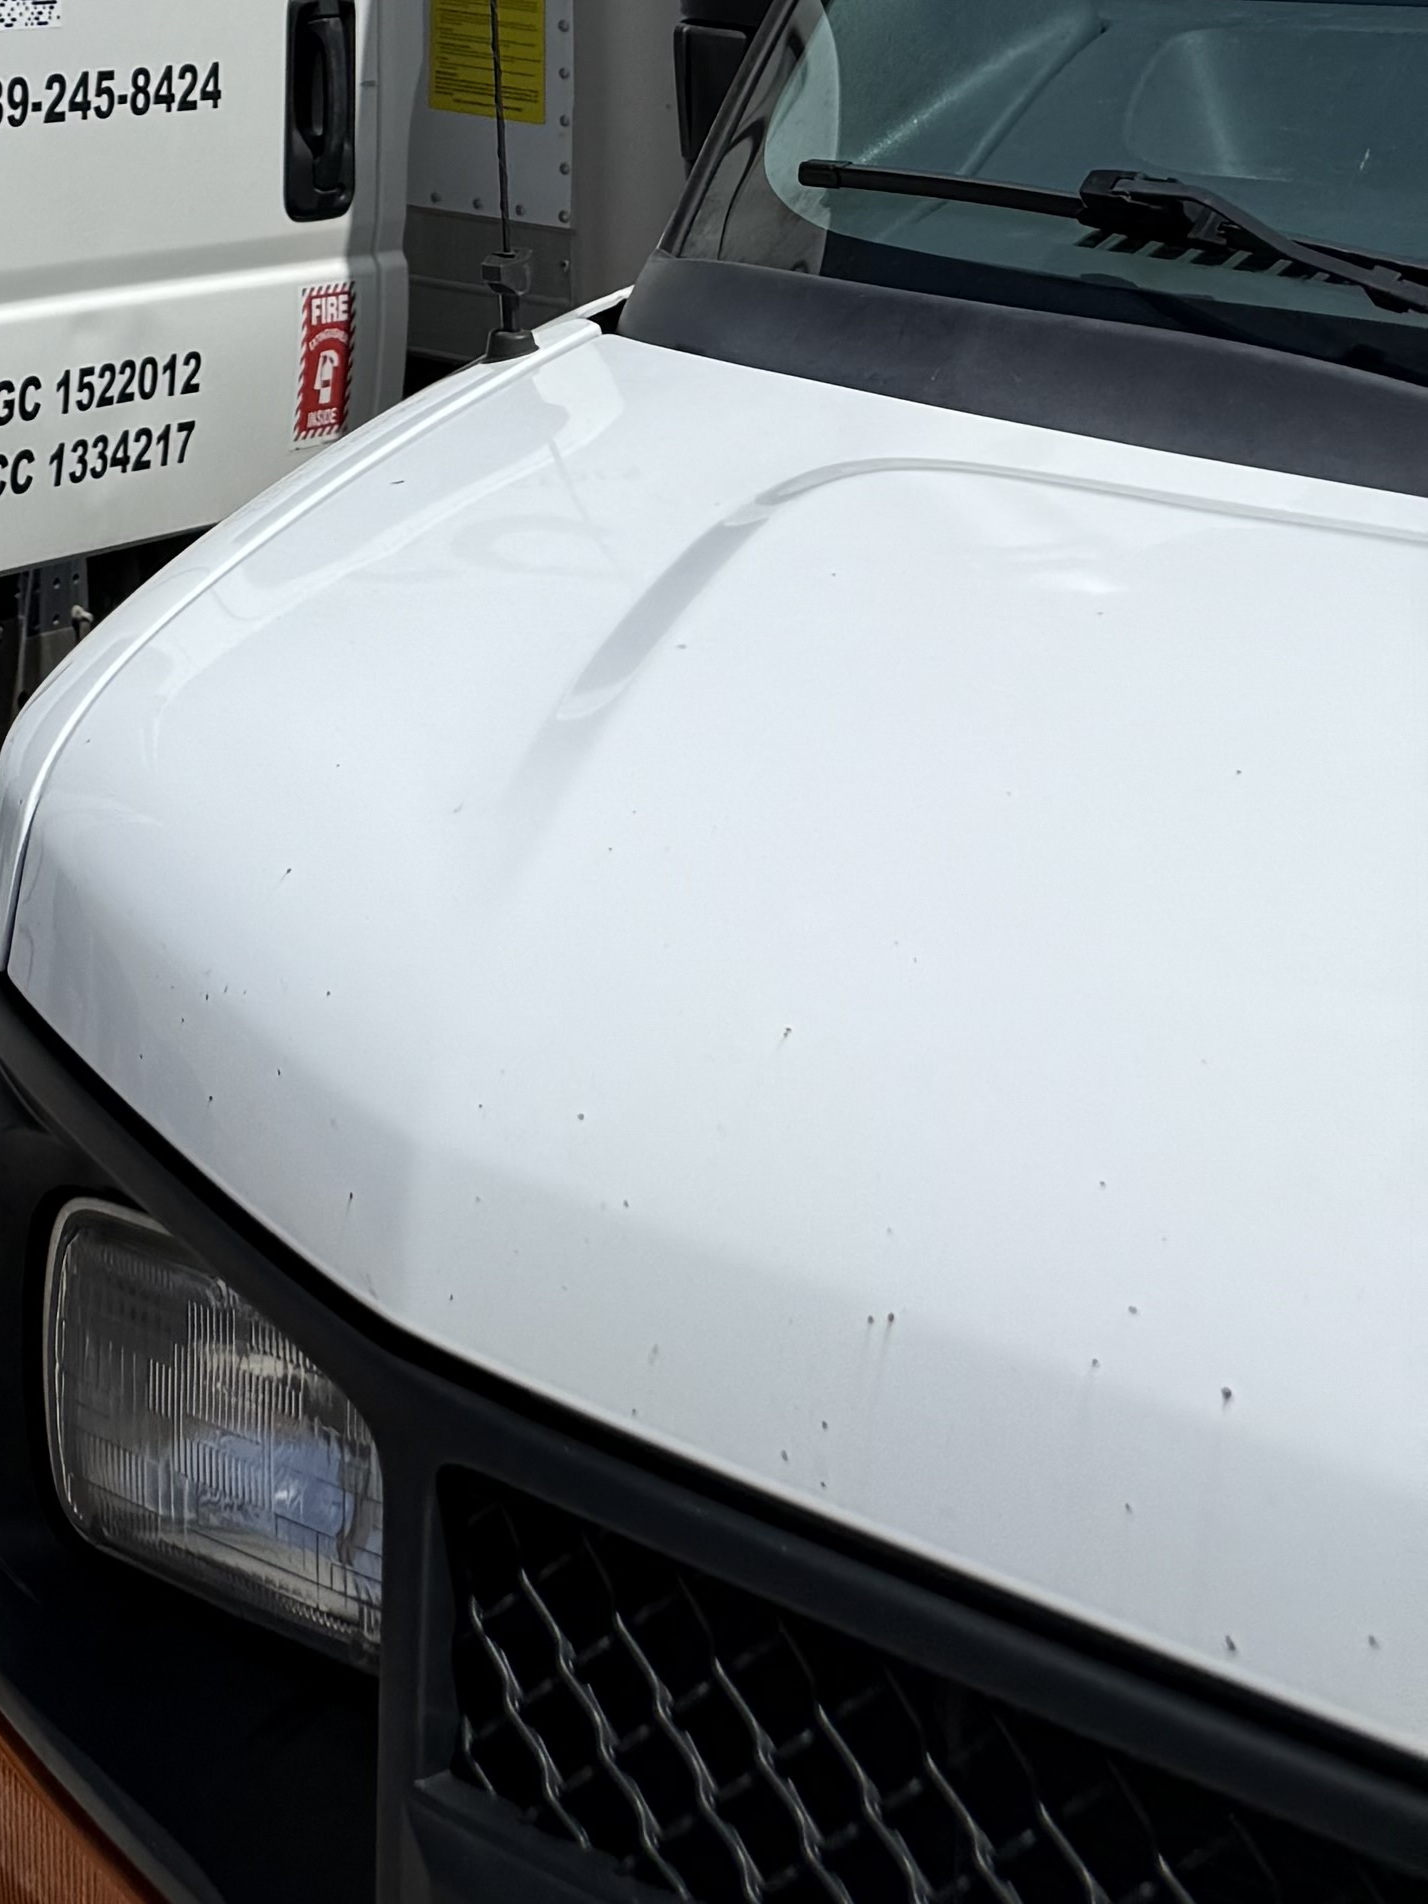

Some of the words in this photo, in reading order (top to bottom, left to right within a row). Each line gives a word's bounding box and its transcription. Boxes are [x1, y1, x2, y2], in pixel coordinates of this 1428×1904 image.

[311, 294, 349, 326] FIRE
[55, 351, 202, 415] 1522012
[307, 407, 338, 428] INSIDE
[47, 420, 196, 488] 1334217
